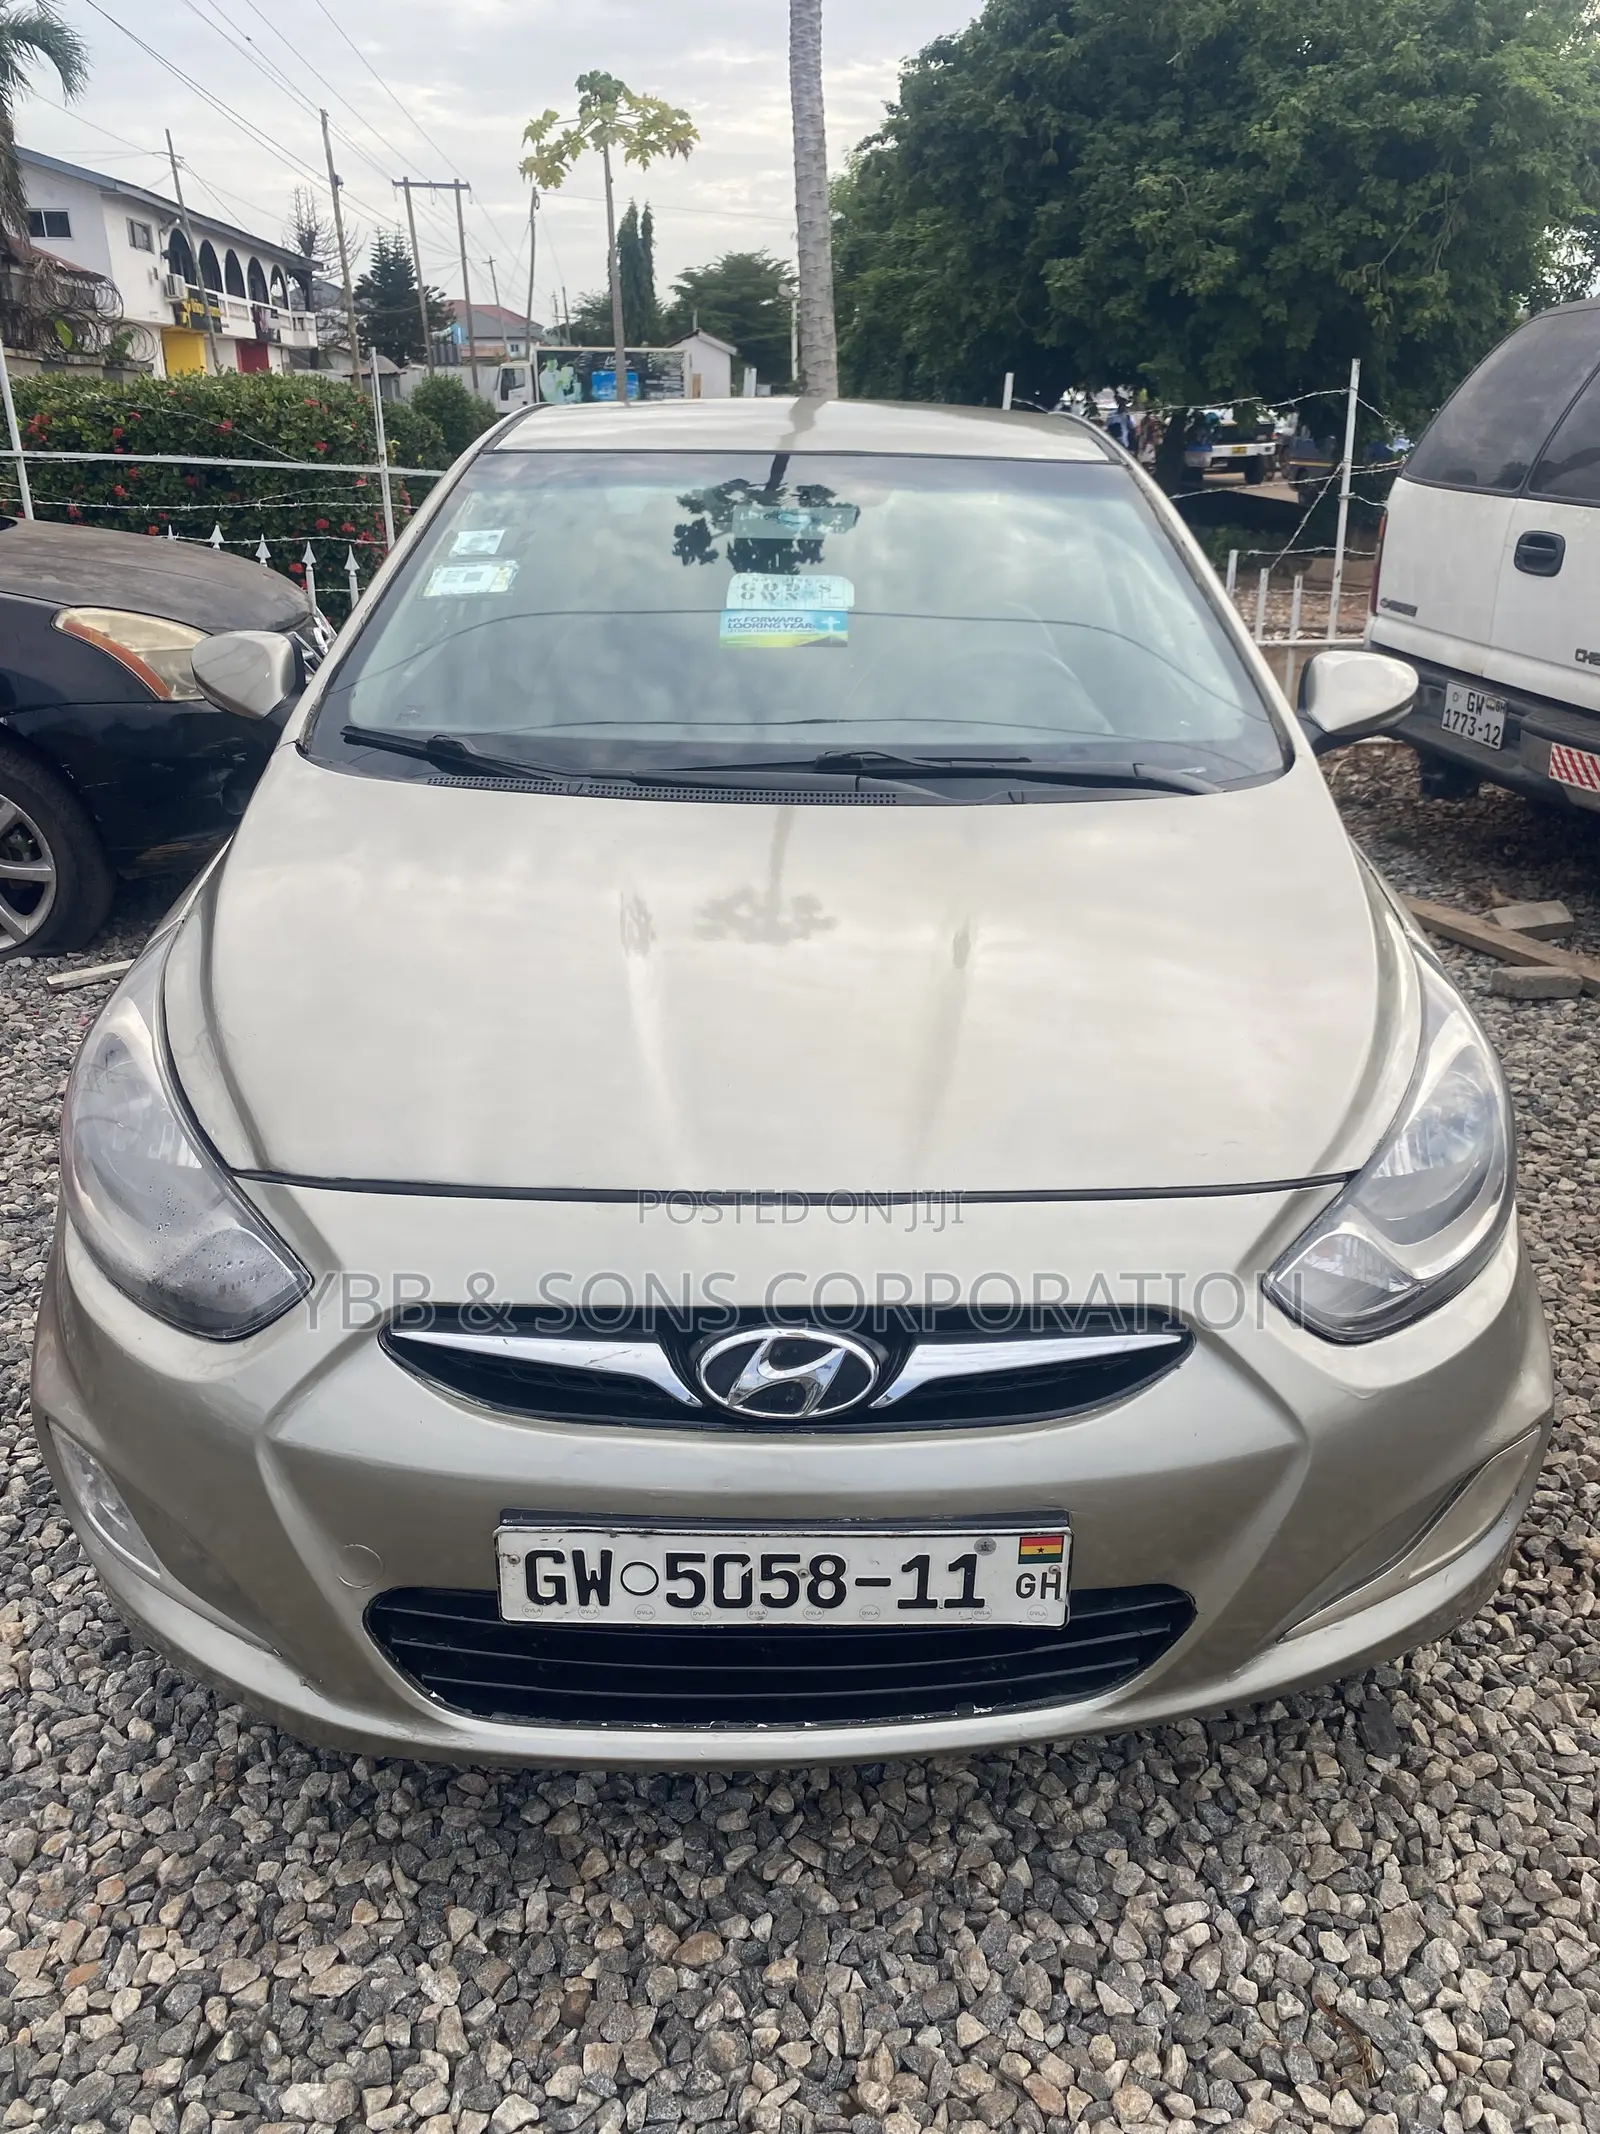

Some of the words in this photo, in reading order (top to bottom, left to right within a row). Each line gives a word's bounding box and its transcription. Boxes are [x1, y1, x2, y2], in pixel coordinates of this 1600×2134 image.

[1467, 692, 1485, 716] GW
[1443, 708, 1501, 746] 1773-12
[525, 1549, 613, 1607] GW
[665, 1552, 986, 1610] 5058-11
[1016, 1571, 1062, 1600] GH
